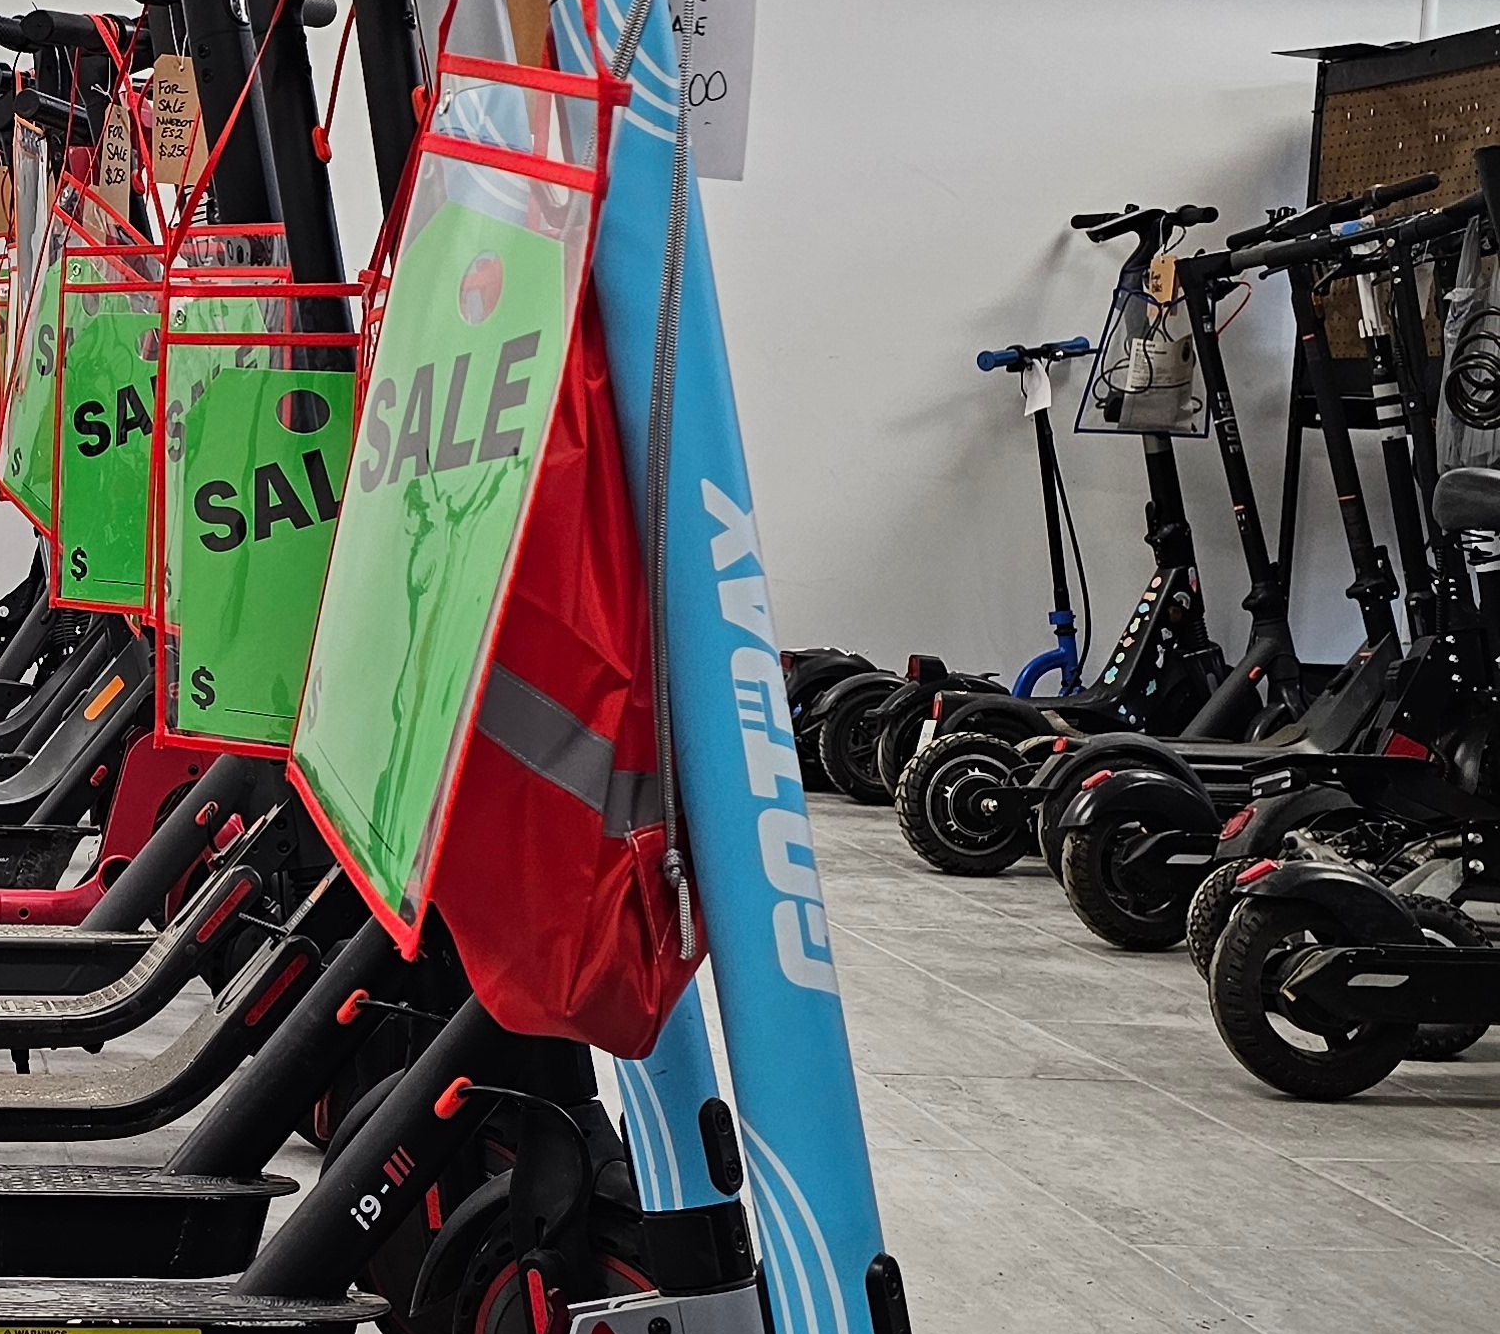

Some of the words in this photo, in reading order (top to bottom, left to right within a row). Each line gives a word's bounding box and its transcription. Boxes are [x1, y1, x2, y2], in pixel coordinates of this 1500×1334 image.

[158, 79, 189, 95] FOR
[158, 98, 186, 114] SALE
[107, 124, 125, 141] FOR
[161, 127, 184, 140] ES2
[106, 142, 128, 162] SALE
[72, 373, 159, 458] SA
[359, 329, 542, 495] SALE
[193, 447, 343, 554] SAL
[70, 547, 88, 582] $
[190, 665, 216, 711] $
[700, 477, 842, 996] GOTRAX
